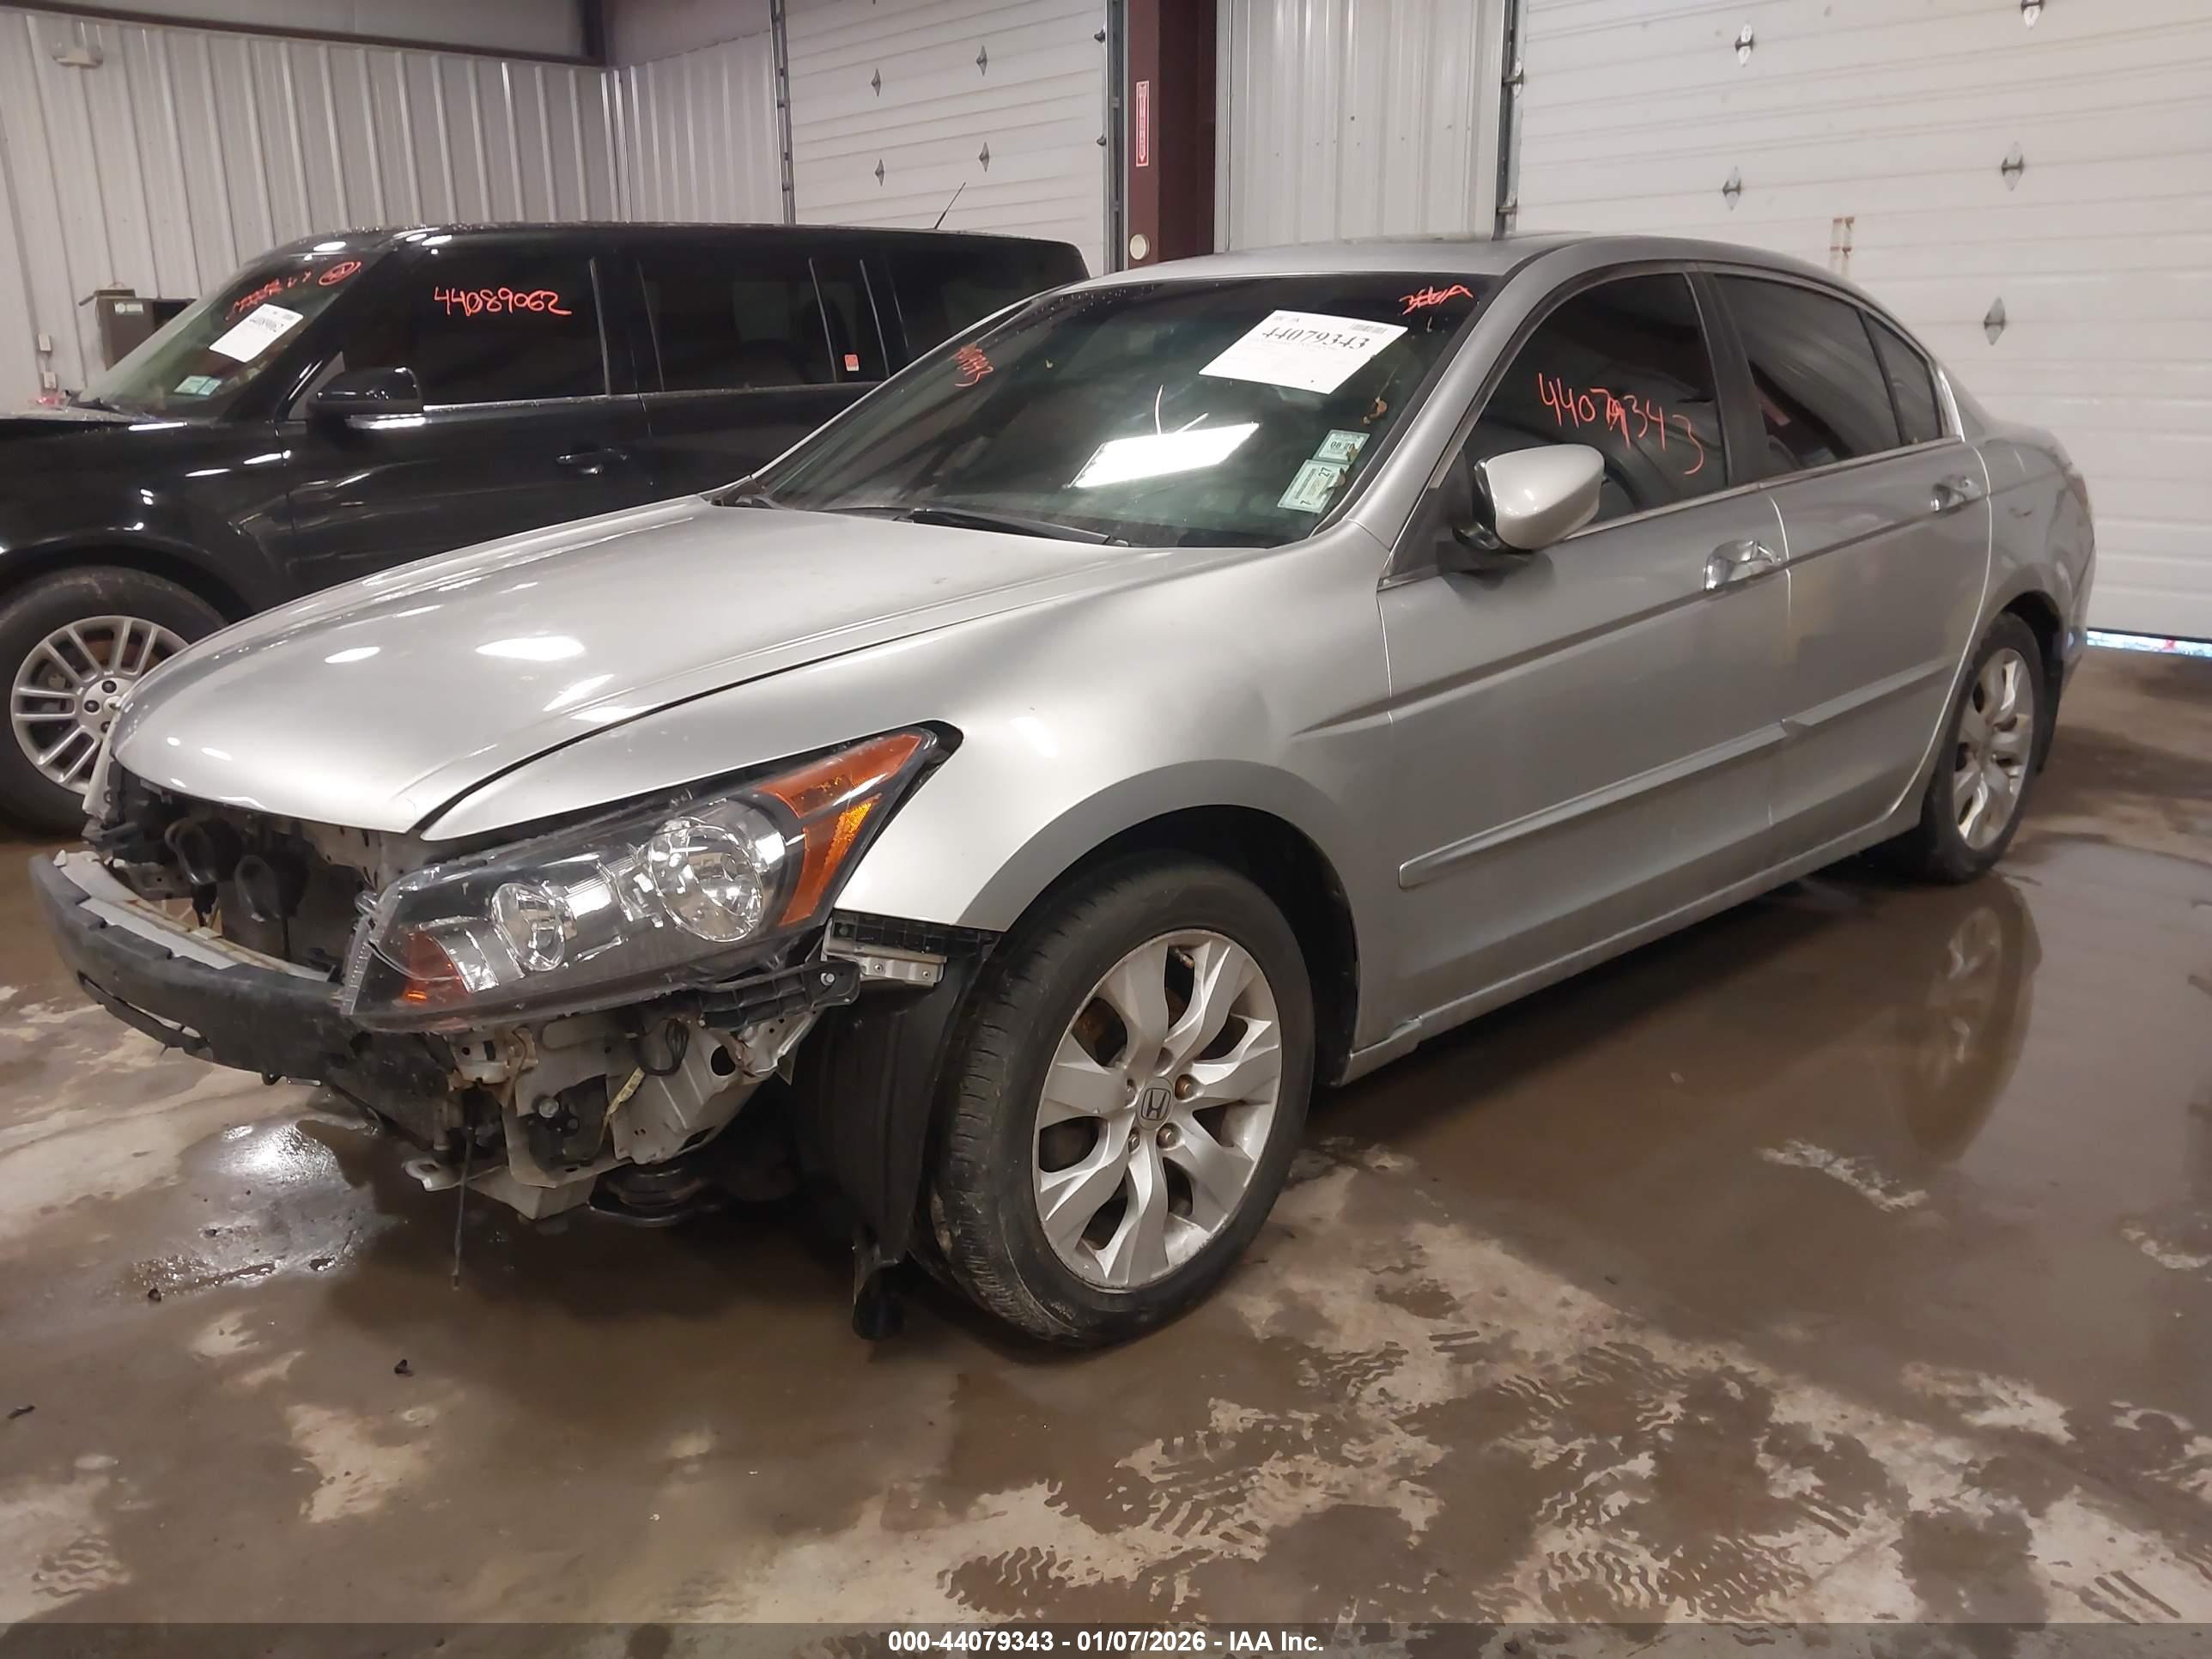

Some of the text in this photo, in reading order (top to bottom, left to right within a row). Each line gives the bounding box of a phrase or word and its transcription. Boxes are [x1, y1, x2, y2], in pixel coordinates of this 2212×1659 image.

[434, 286, 573, 317] 44089062
[1261, 326, 1370, 350] 44079343
[1538, 372, 1705, 476] 44079343
